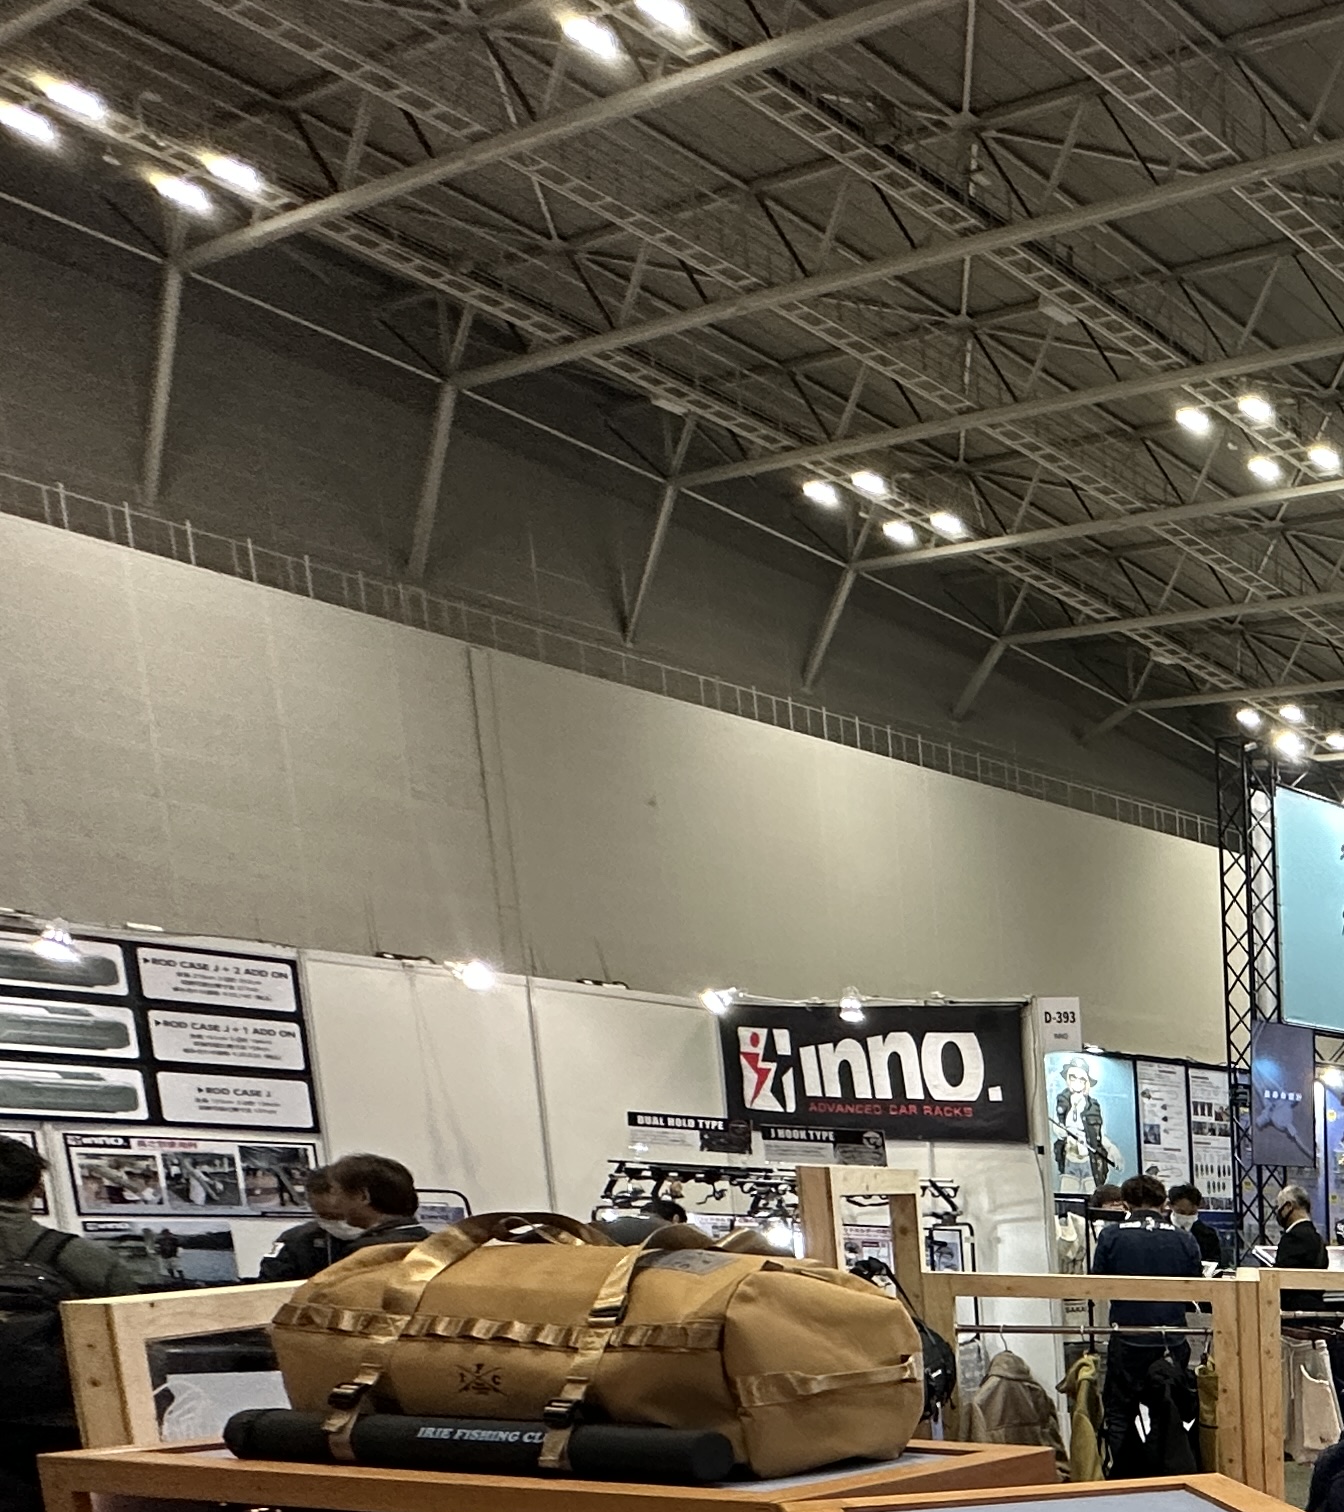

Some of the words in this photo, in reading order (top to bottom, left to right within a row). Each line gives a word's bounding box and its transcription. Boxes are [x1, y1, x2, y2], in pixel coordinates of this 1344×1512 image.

[151, 957, 176, 967] ROD
[179, 960, 209, 971] CASE
[243, 967, 269, 978] ADD
[271, 970, 289, 980] ON
[1044, 1011, 1076, 1025] D-393
[162, 1019, 188, 1030] ROD
[191, 1022, 221, 1033] CASE
[252, 1027, 276, 1038] ADD
[279, 1030, 296, 1039] ON
[205, 1086, 230, 1096] ROD
[233, 1088, 263, 1098] CASE
[808, 1102, 883, 1116] ADVANCED
[888, 1103, 918, 1116] CAR
[923, 1104, 973, 1118] RACKS
[636, 1114, 664, 1127] DUAL
[667, 1117, 696, 1129] HOLD
[698, 1119, 724, 1131] TYPE
[777, 1128, 807, 1140] HOOK
[808, 1130, 834, 1142] TYPE
[417, 1427, 453, 1440] IRIE
[453, 1428, 520, 1442] FISHING
